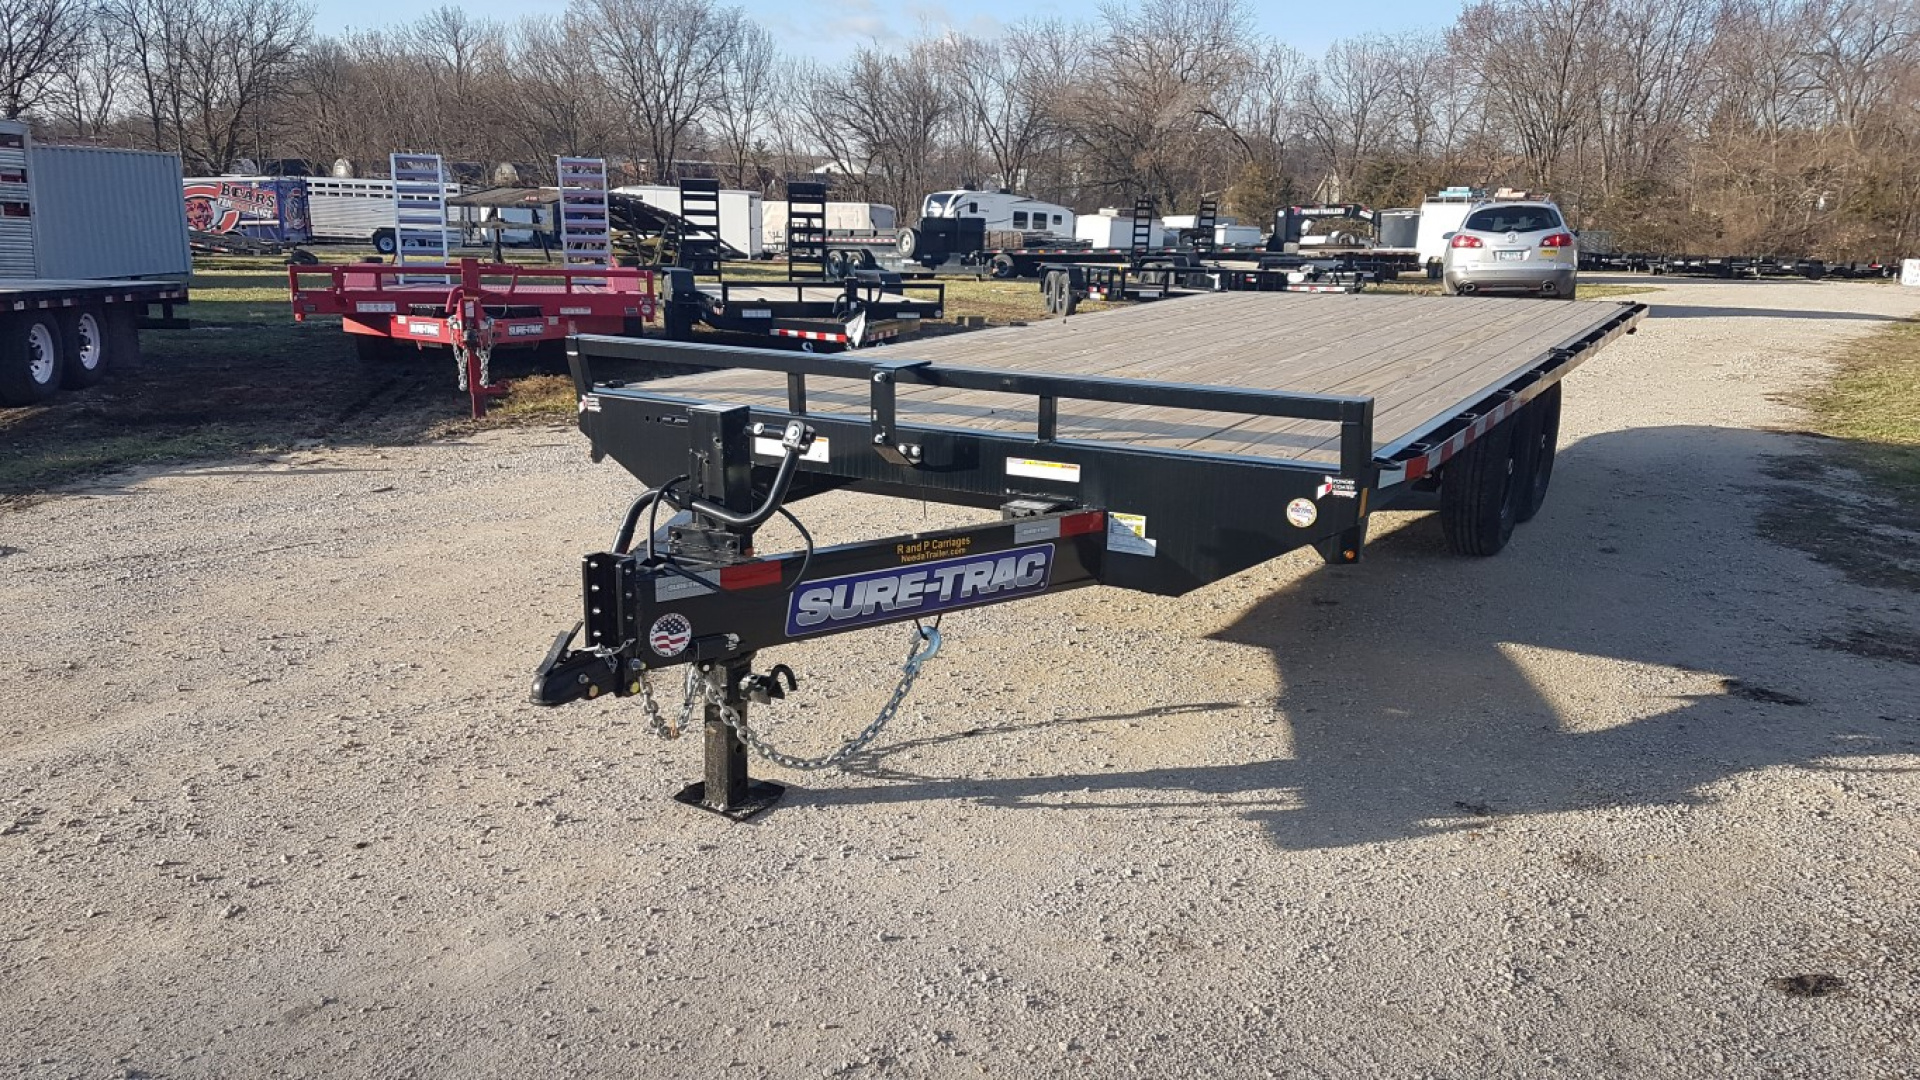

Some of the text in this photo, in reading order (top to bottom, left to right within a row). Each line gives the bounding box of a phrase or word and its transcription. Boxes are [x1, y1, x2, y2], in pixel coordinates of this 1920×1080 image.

[221, 182, 275, 207] BEARS
[508, 324, 544, 336] SURE-TRAC
[896, 537, 972, 555] R and P Carriages
[796, 552, 1046, 627] SURE-TRAC
